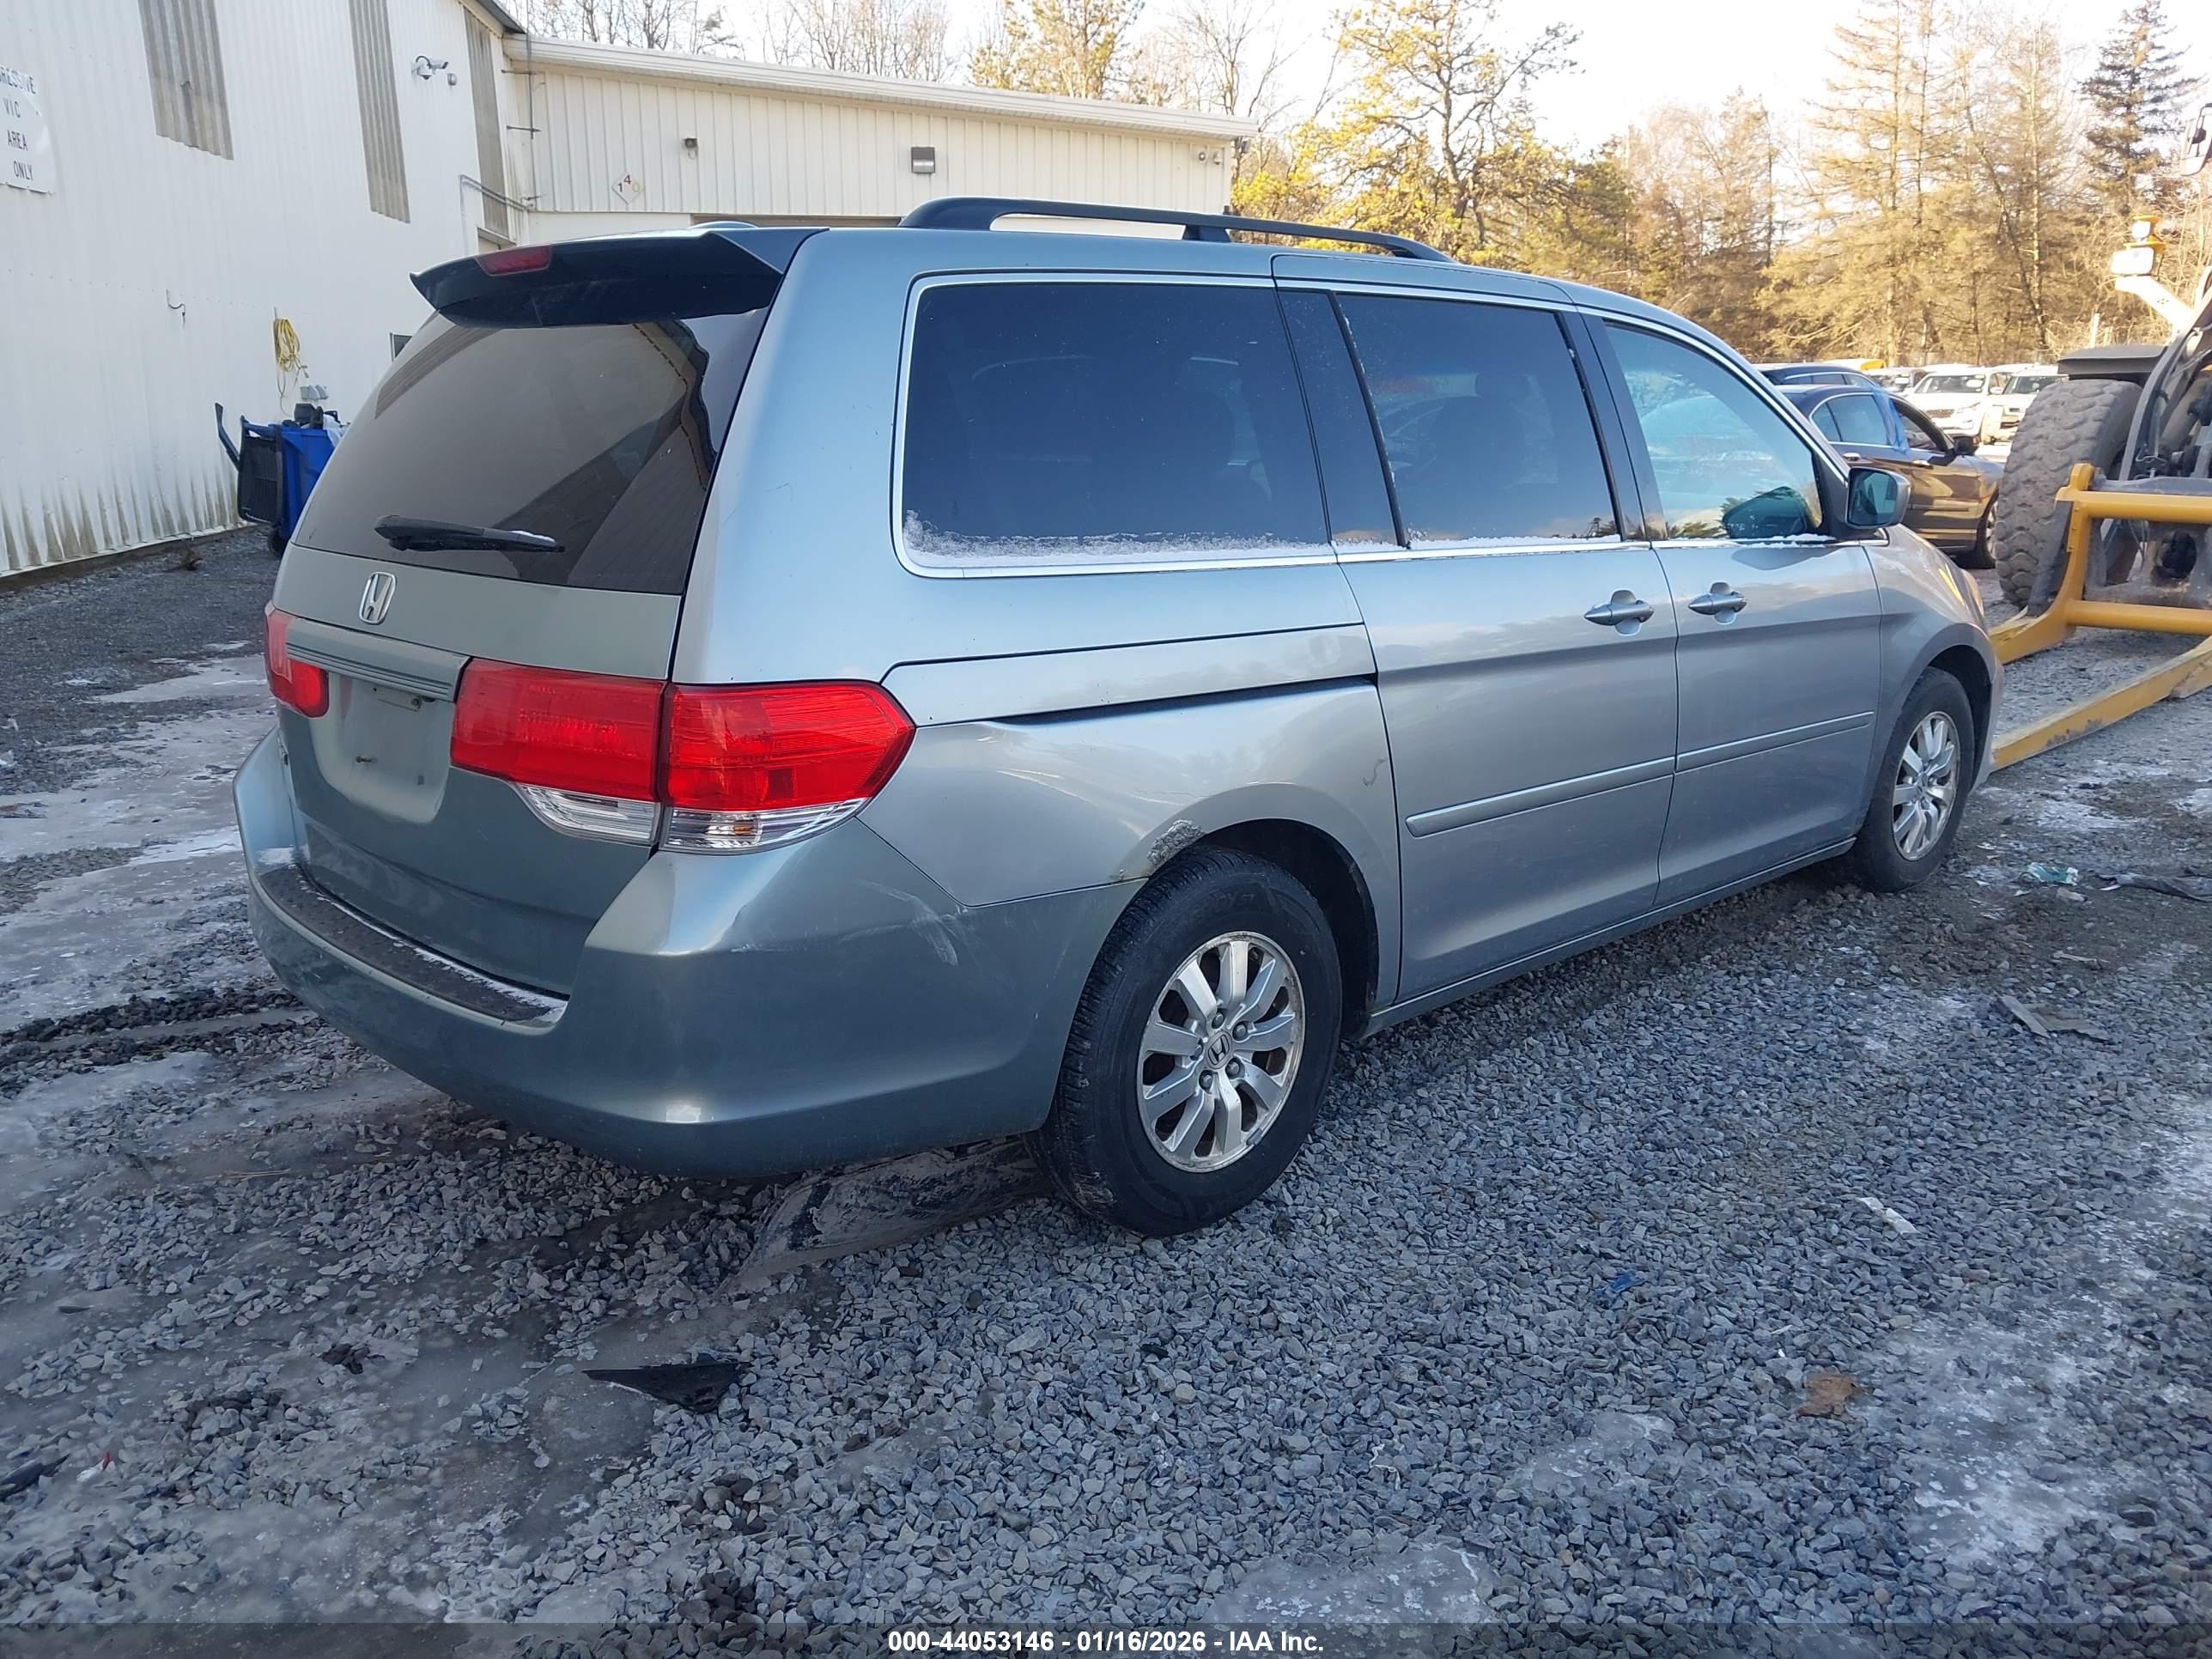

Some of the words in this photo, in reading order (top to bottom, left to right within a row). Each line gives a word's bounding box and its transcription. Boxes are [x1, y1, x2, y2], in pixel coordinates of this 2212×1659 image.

[0, 66, 36, 94] RESSIVE
[3, 98, 21, 118] VIC
[7, 130, 27, 151] AREA
[13, 160, 33, 181] ONLY
[623, 174, 632, 185] 4
[617, 182, 623, 192] 1
